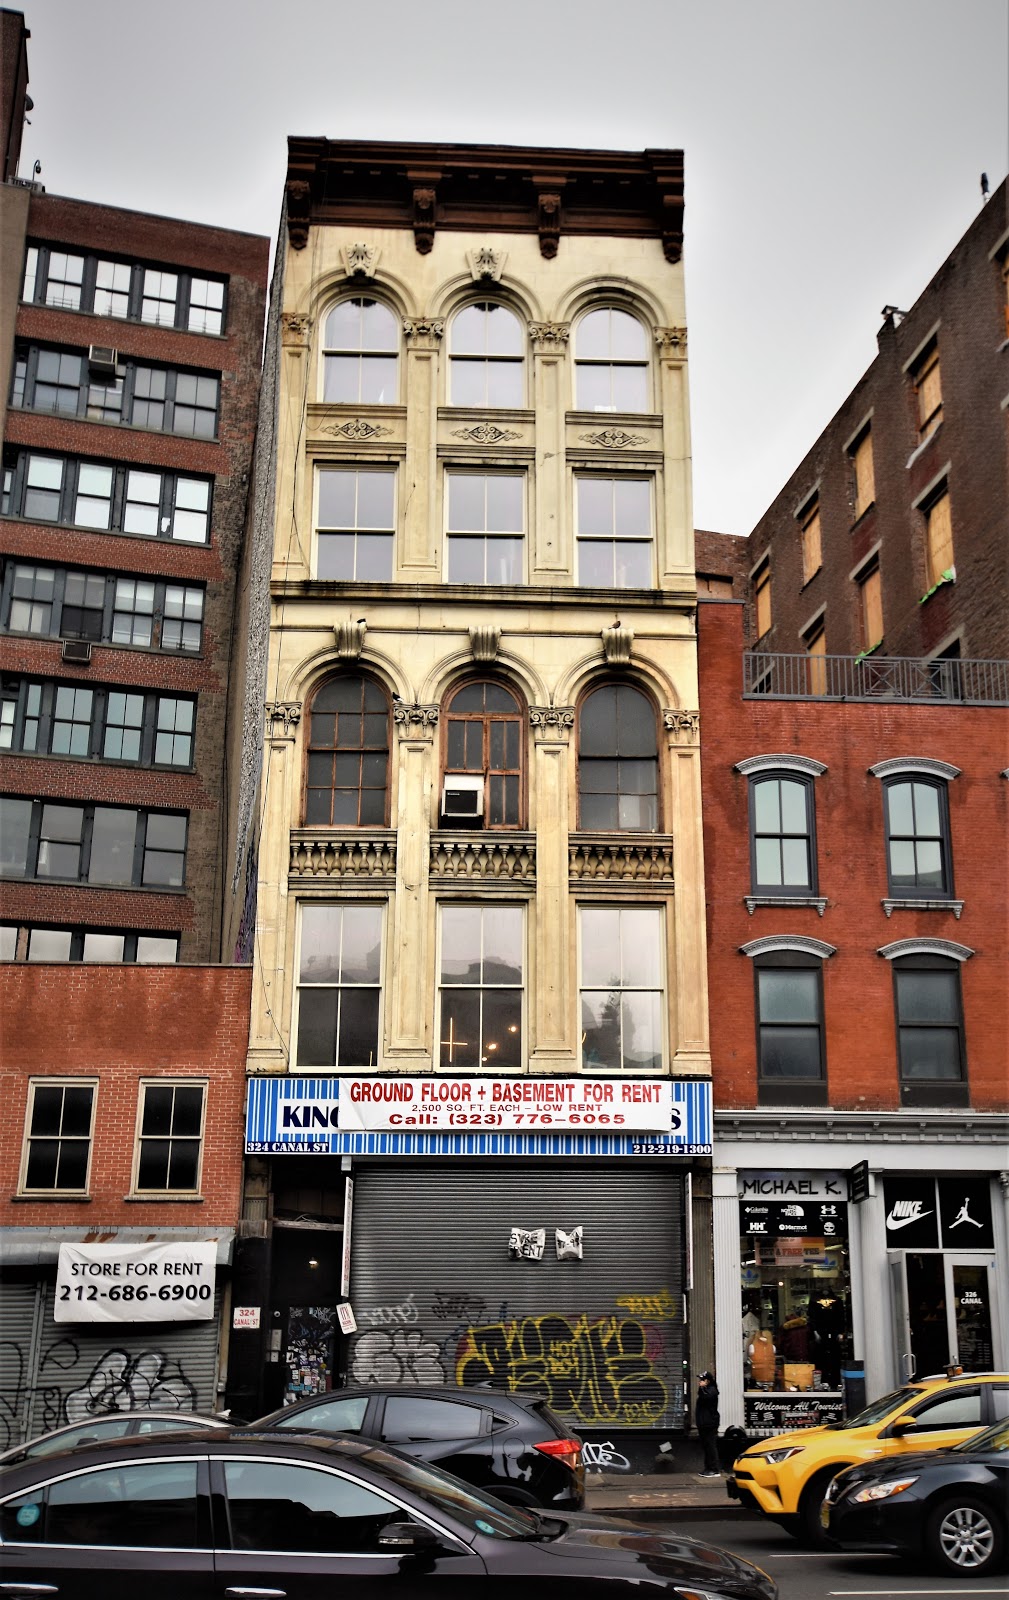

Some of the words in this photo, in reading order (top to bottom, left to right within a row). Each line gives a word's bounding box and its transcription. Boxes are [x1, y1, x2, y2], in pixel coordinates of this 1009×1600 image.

[351, 1082, 413, 1102] GROUND
[421, 1083, 471, 1102] FLOOR
[478, 1086, 486, 1100] +
[493, 1083, 575, 1102] BASEMENT
[584, 1083, 614, 1102] FOR
[622, 1084, 662, 1103] RENT
[412, 1104, 441, 1112] 2,500
[446, 1104, 465, 1112] SQ.
[470, 1104, 484, 1112] FT.
[490, 1104, 520, 1112] EACH
[536, 1104, 562, 1112] LOW
[569, 1104, 602, 1112] RENT
[389, 1113, 437, 1125] Call:
[449, 1113, 502, 1126] (323)
[247, 1142, 269, 1152] 324
[272, 1142, 310, 1152] CANAL
[313, 1142, 328, 1152] ST
[633, 1144, 711, 1154] 212-219-1300
[743, 1179, 819, 1194] MICHAEL
[825, 1180, 842, 1195] K.
[892, 1200, 923, 1217] NIKE
[749, 1222, 764, 1231] HH
[72, 1262, 121, 1276] STORE
[126, 1262, 159, 1276] FOR
[163, 1262, 203, 1276] RENT
[60, 1284, 212, 1301] 212-686-6900
[754, 1401, 791, 1411] Welcome
[793, 1401, 810, 1411] All
[811, 1401, 843, 1411] Tourist
